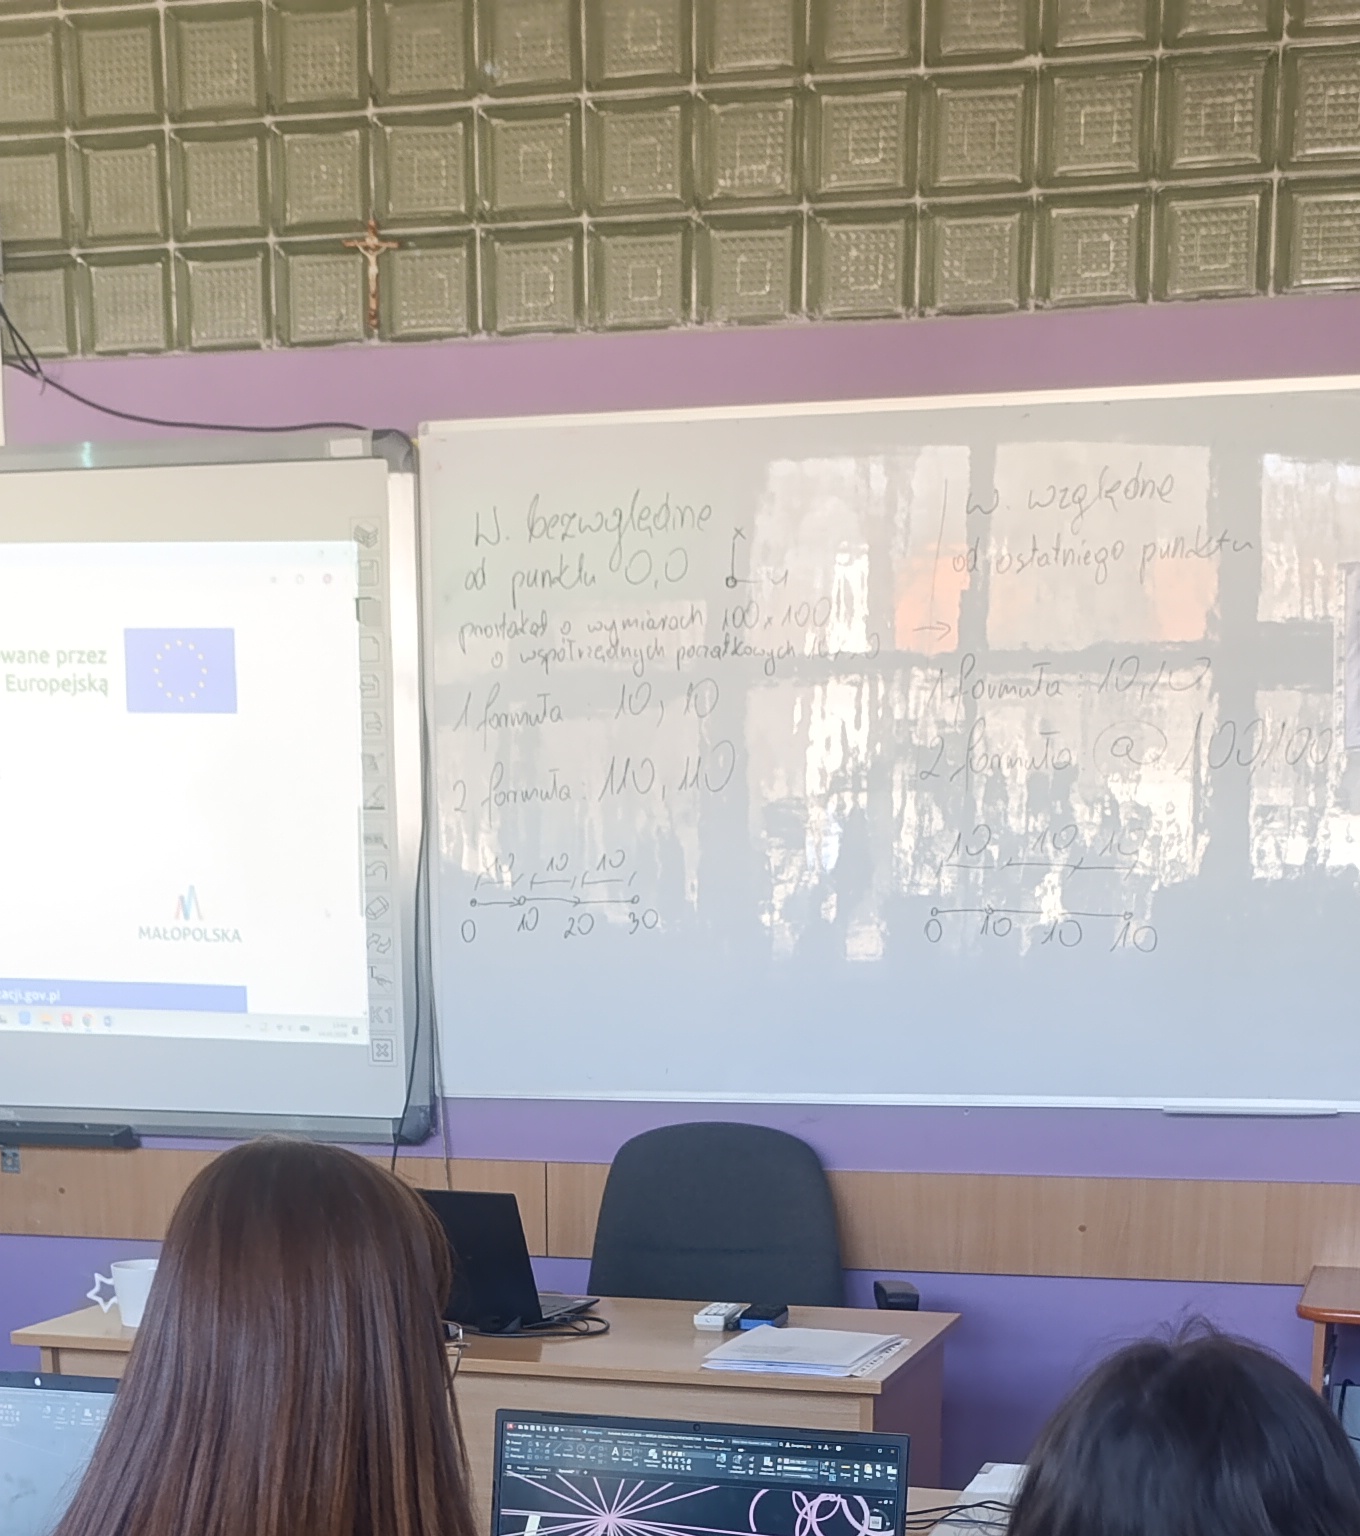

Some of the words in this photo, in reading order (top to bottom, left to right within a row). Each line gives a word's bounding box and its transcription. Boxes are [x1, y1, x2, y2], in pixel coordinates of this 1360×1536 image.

[951, 534, 981, 575] od
[464, 556, 488, 592] od
[56, 648, 108, 670] przez
[5, 673, 110, 698] Europejską
[137, 925, 243, 944] MAŁOPOLSKA
[460, 917, 477, 944] 0
[516, 906, 540, 933] 10
[563, 911, 596, 940] 20
[627, 907, 659, 936] 30
